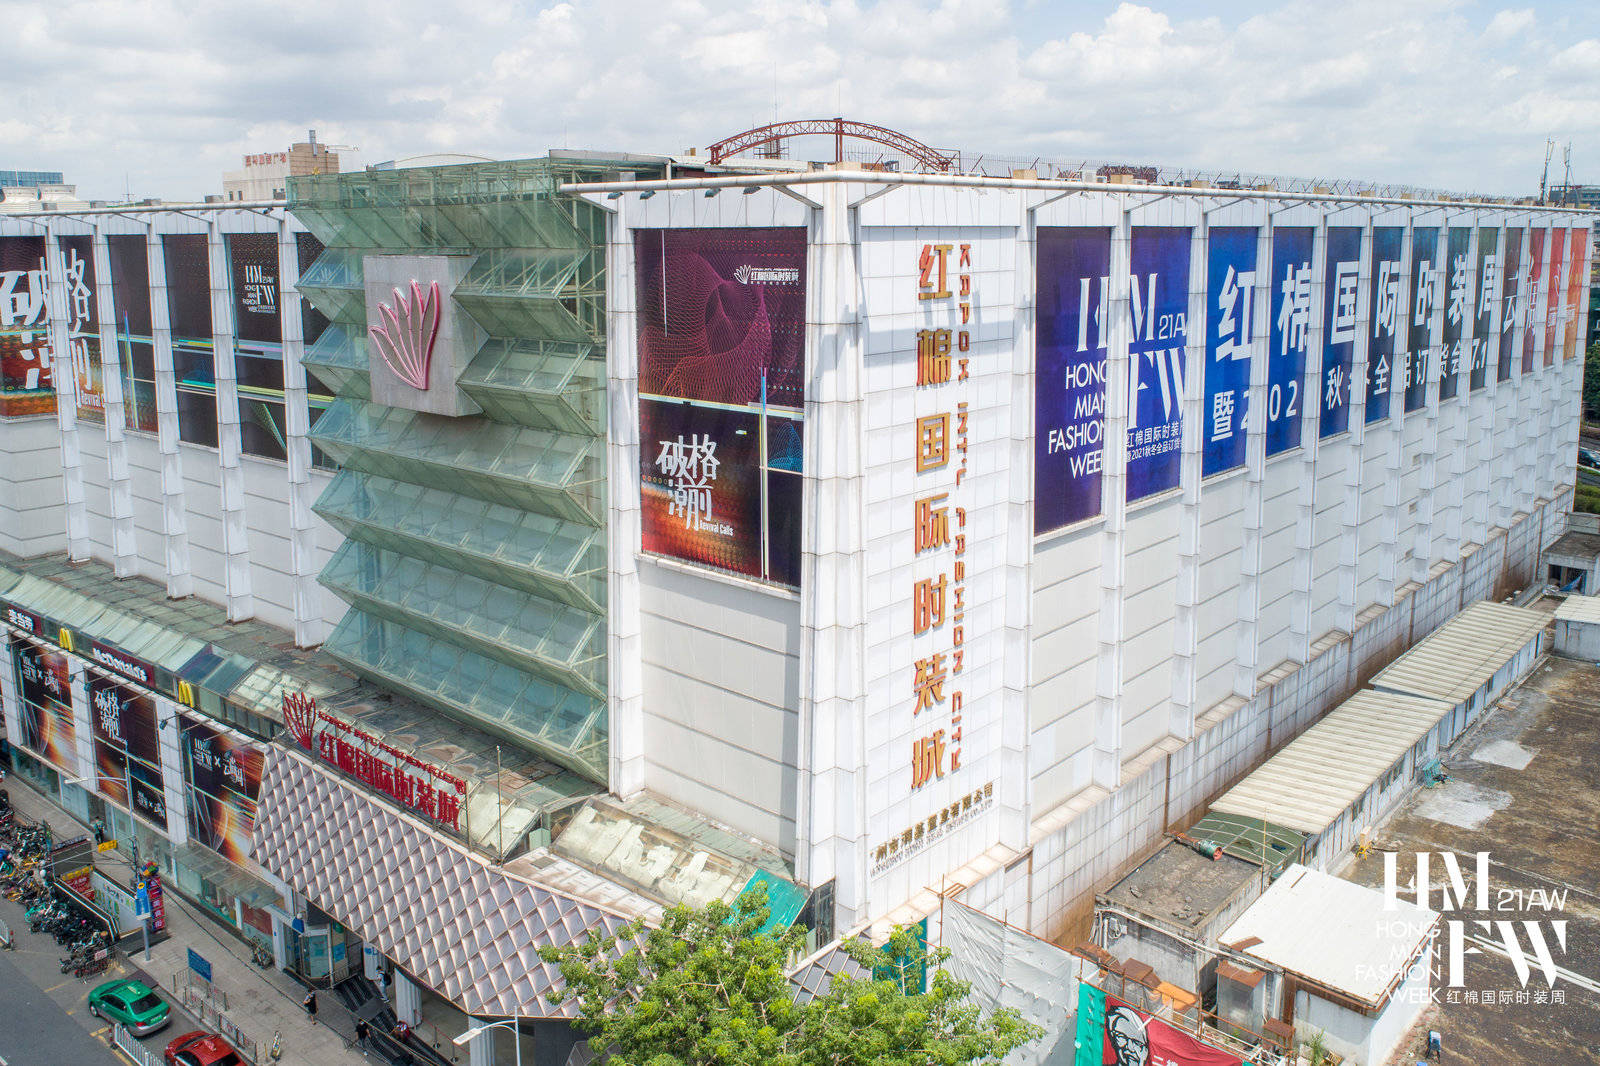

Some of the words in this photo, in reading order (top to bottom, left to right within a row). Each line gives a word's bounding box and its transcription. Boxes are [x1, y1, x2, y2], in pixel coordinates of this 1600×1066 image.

[957, 244, 971, 382] KAPOK
[1158, 311, 1188, 341] 21A
[1069, 449, 1104, 479] WEE
[1126, 420, 1183, 448] 红棉国际时装
[911, 244, 955, 790] 红棉国际时装城
[953, 507, 967, 674] FASHION
[951, 690, 963, 772] CITY
